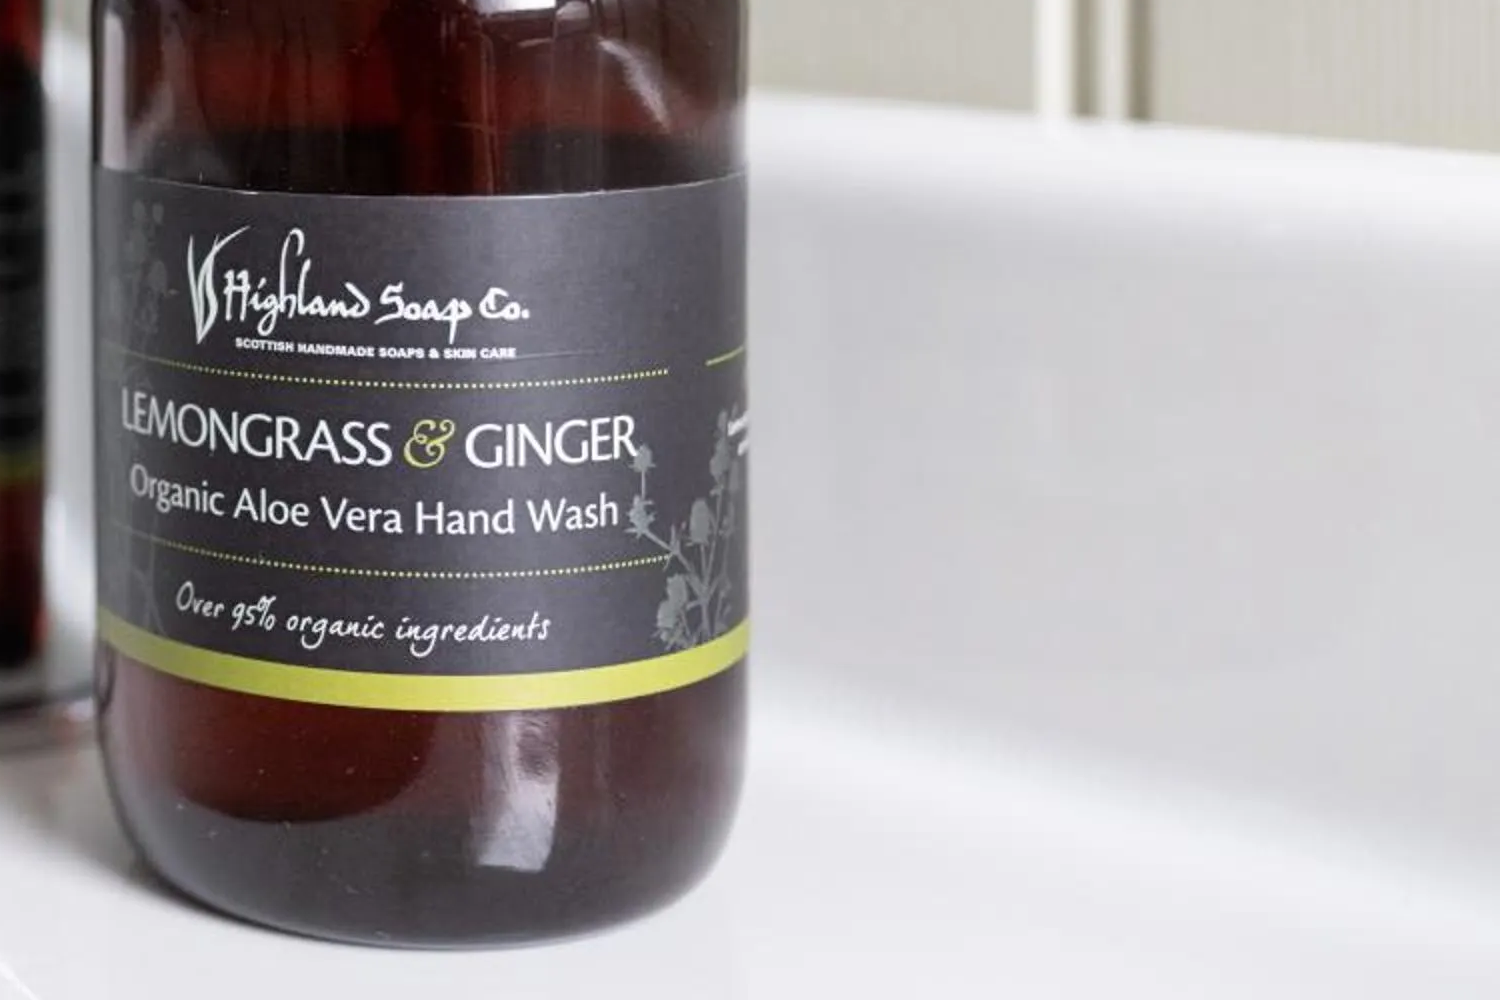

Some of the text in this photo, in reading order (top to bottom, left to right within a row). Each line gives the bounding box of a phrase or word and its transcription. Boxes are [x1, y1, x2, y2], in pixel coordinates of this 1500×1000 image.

[221, 227, 531, 345] Highland Soap Co.
[235, 336, 517, 360] SCOTTISH HANDMADE SOAPS & SKIN CARE
[120, 386, 639, 469] LEMONGRASS & GINGER
[130, 464, 619, 535] Organic Aloe Vera Hand Wash
[176, 580, 551, 658] Over 95% organic ingredients
